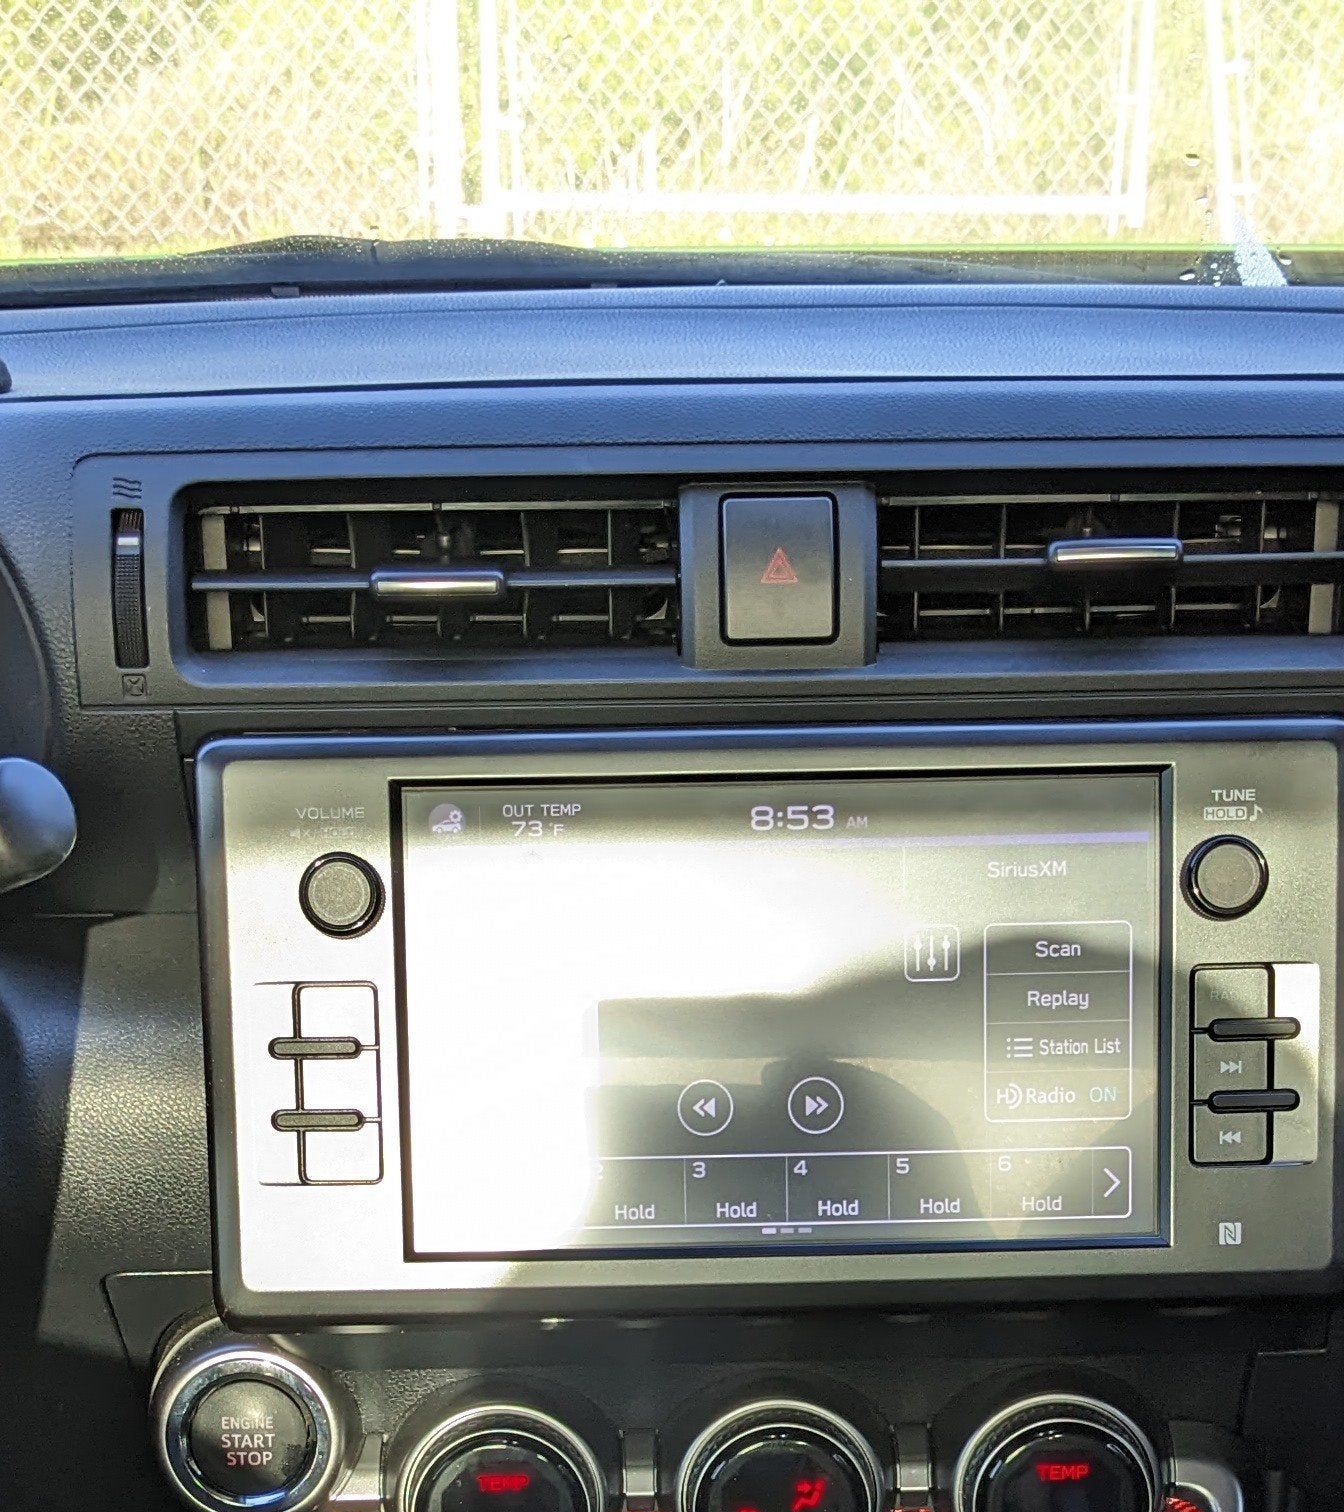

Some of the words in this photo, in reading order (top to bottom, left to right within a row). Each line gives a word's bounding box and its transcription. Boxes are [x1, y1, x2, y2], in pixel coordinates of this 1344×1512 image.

[1211, 788, 1256, 802] TUNE
[295, 806, 365, 819] VOLUME
[502, 804, 535, 818] OUT
[542, 803, 581, 817] TEMP
[750, 804, 835, 831] 8:53
[846, 816, 868, 829] AM
[1204, 807, 1247, 820] HOLD
[511, 821, 543, 837] 73
[987, 860, 1067, 878] SiriusXM
[1035, 940, 1082, 958] Scan
[1027, 989, 1090, 1010] Replay
[1039, 1038, 1089, 1055] Station
[1094, 1037, 1122, 1054] List
[1026, 1086, 1076, 1104] Radio
[1089, 1086, 1117, 1103] ON
[692, 1161, 707, 1179] 3
[793, 1159, 808, 1176] 4
[896, 1157, 910, 1175] 5
[998, 1155, 1012, 1172] 6
[614, 1204, 655, 1220] Hold
[716, 1201, 757, 1219] Hold
[817, 1199, 859, 1217] Hold
[920, 1198, 961, 1215] Hold
[1022, 1196, 1063, 1212] Hold
[221, 1416, 274, 1431] ENGINE
[221, 1433, 276, 1449] START
[226, 1451, 273, 1467] STOP
[1036, 1463, 1089, 1482] TEMP
[476, 1474, 529, 1494] TEMP
